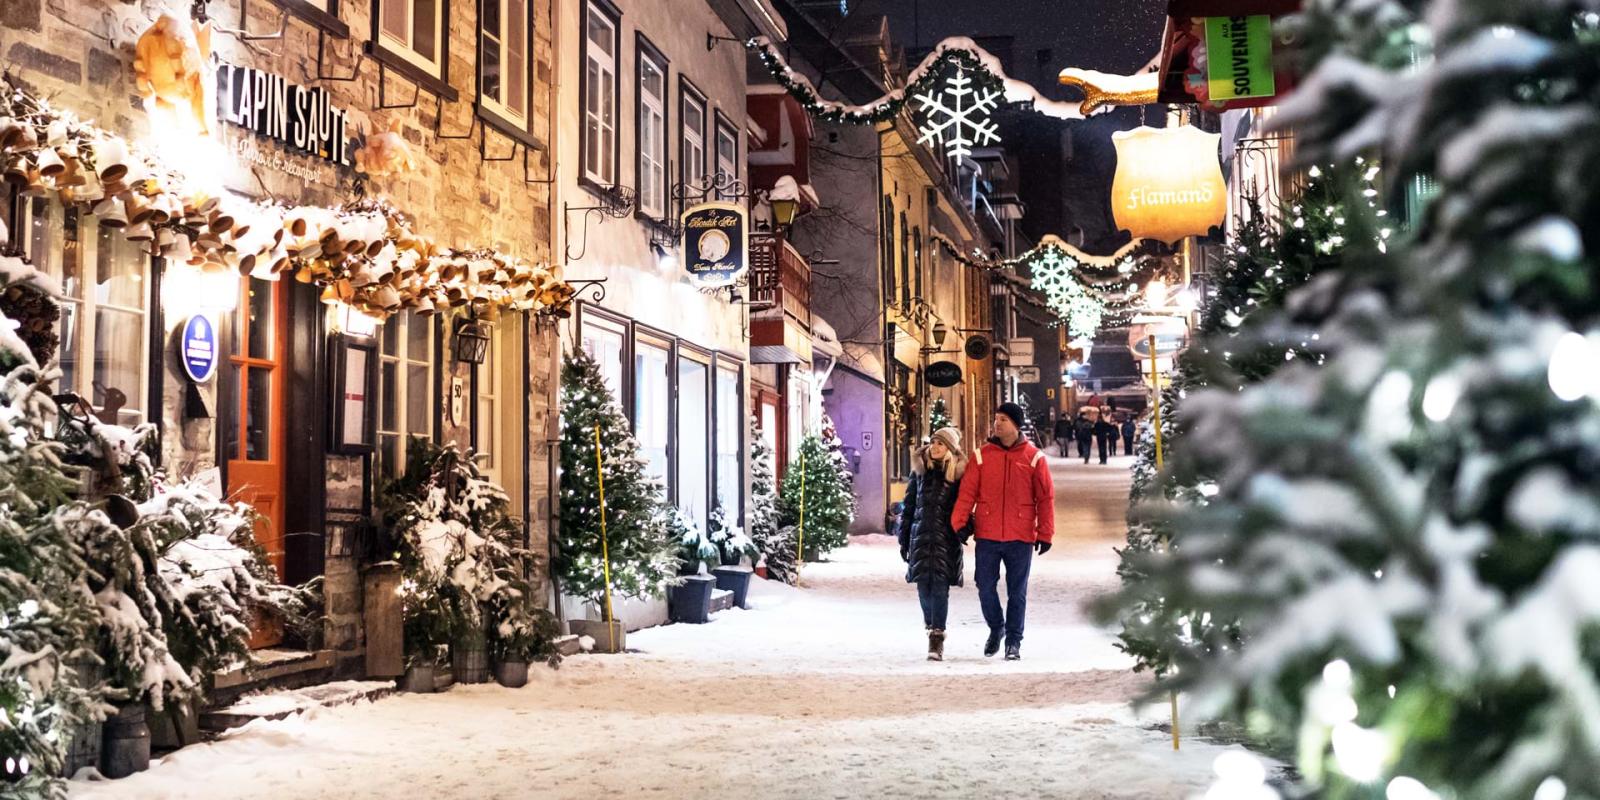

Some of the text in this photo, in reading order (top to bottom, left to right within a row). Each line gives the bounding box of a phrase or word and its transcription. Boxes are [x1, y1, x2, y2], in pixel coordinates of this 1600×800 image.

[1222, 23, 1230, 39] AUX
[1230, 15, 1251, 96] SOUVENIRS
[226, 63, 287, 141] LAPIN
[281, 159, 323, 188] réconfort
[454, 384, 462, 399] 50
